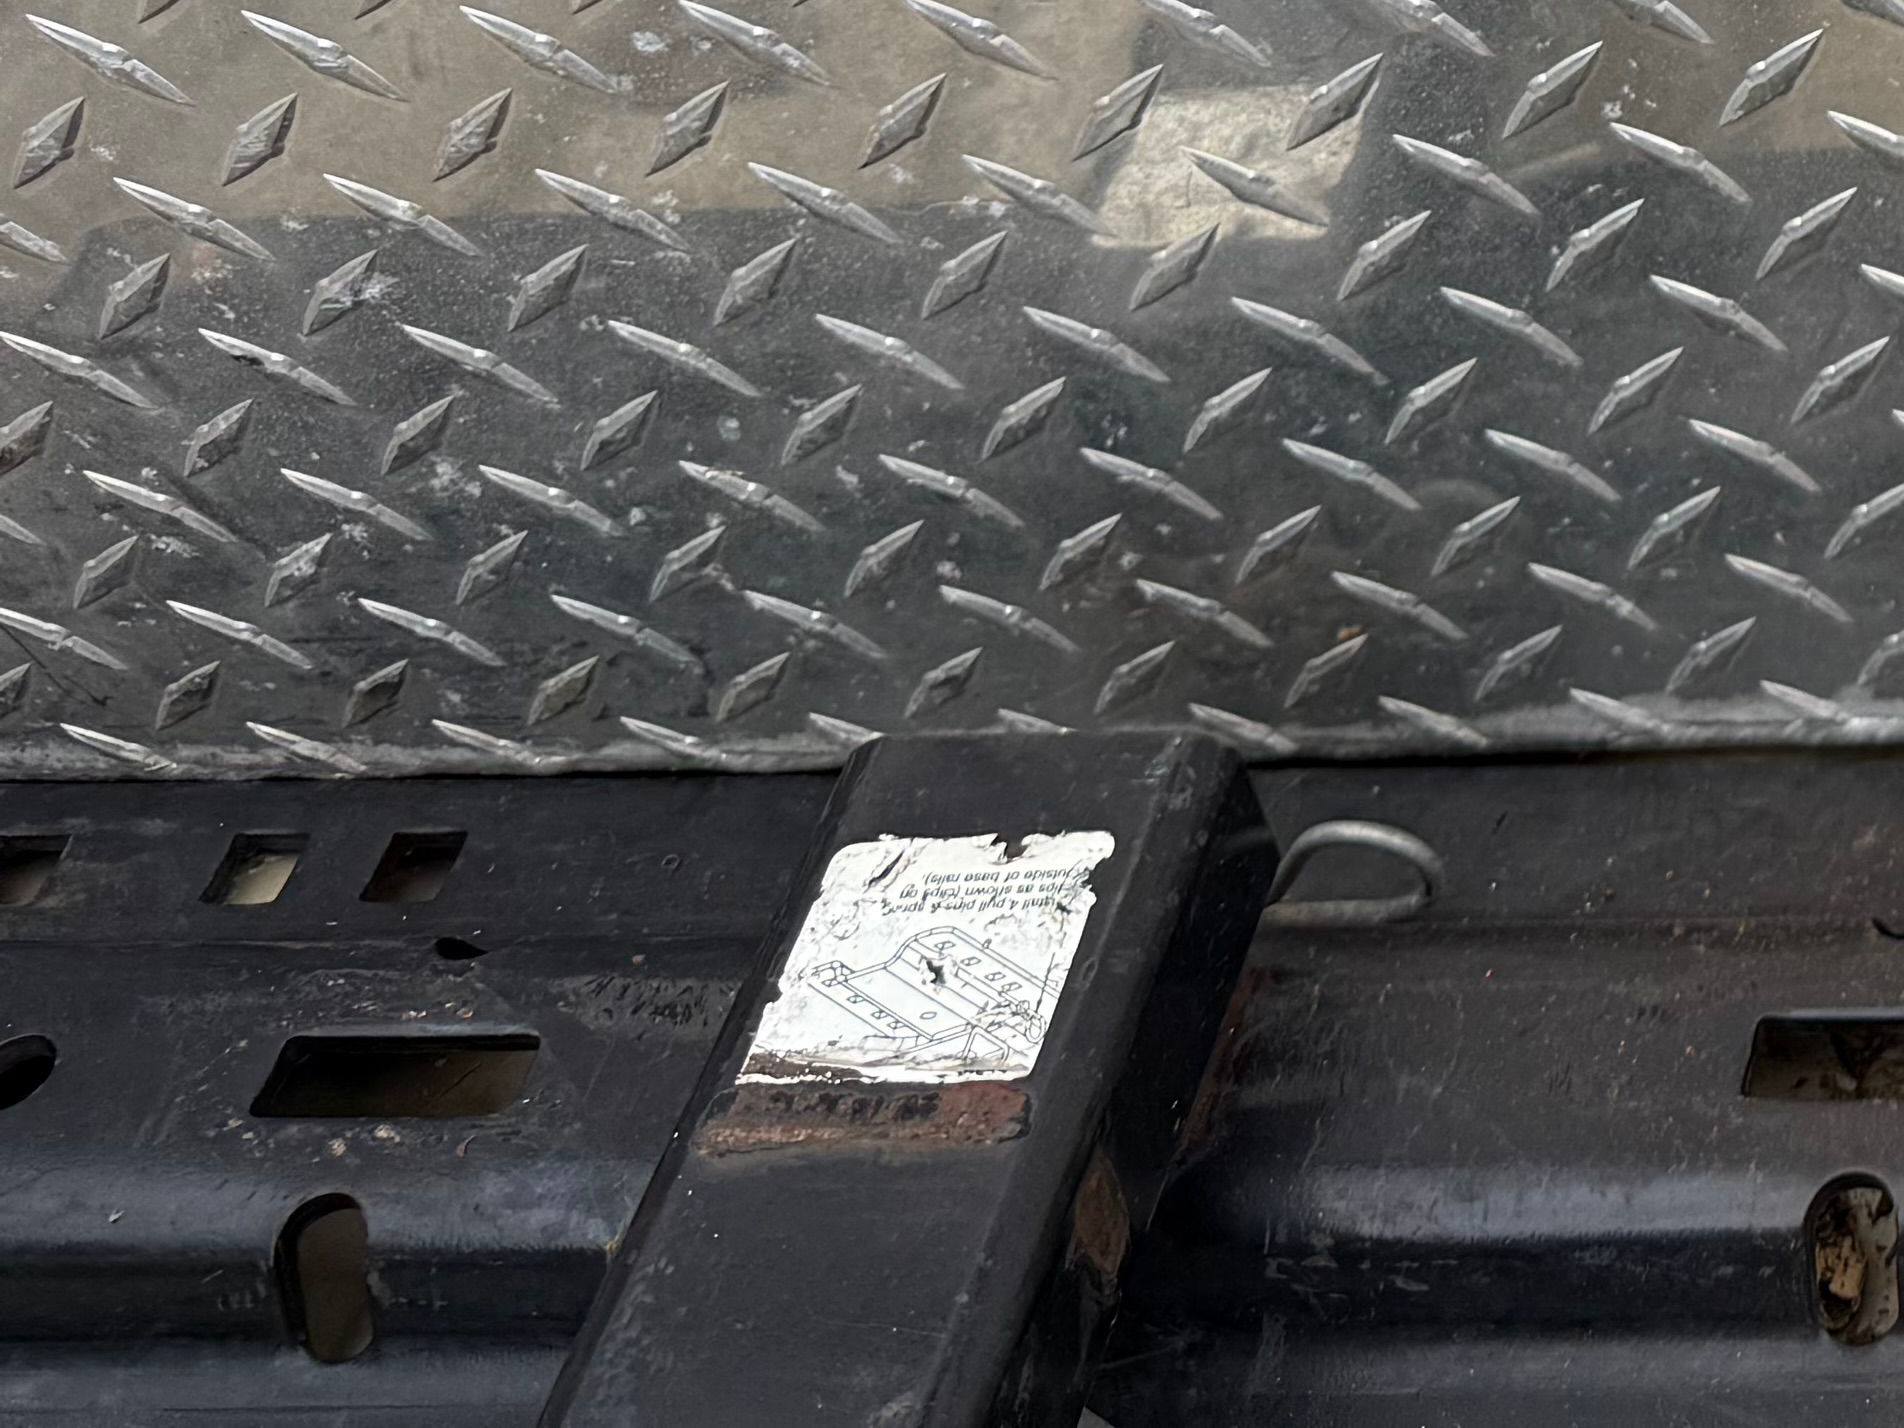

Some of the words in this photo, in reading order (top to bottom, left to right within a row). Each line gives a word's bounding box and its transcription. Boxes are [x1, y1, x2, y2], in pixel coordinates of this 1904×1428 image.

[964, 872, 1000, 885] base
[1023, 869, 1067, 882] utside
[1016, 884, 1034, 894] as
